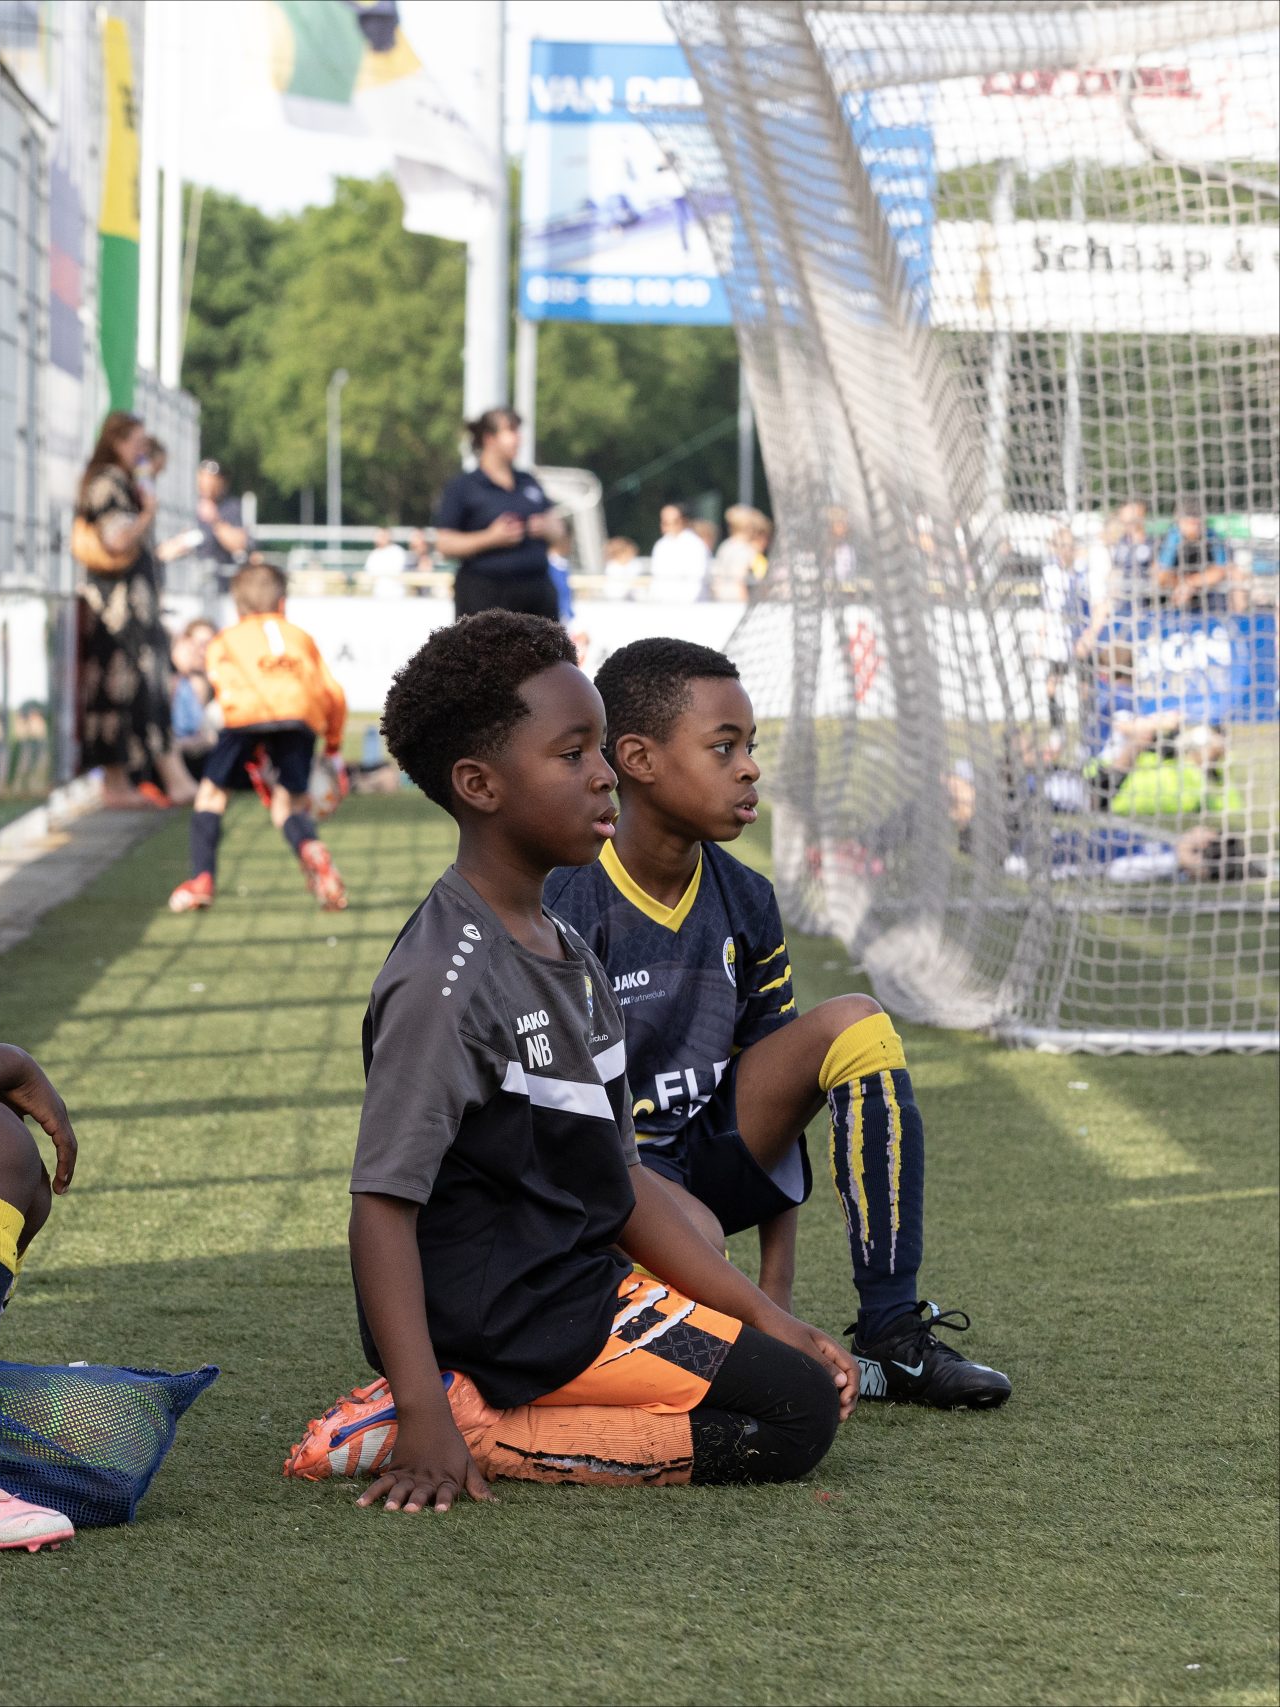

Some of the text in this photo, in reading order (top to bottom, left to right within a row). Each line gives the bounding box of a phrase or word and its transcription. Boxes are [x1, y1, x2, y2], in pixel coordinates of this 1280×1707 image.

[612, 969, 650, 992] JAKO
[516, 1009, 550, 1035] JAKO
[526, 1033, 553, 1069] NB
